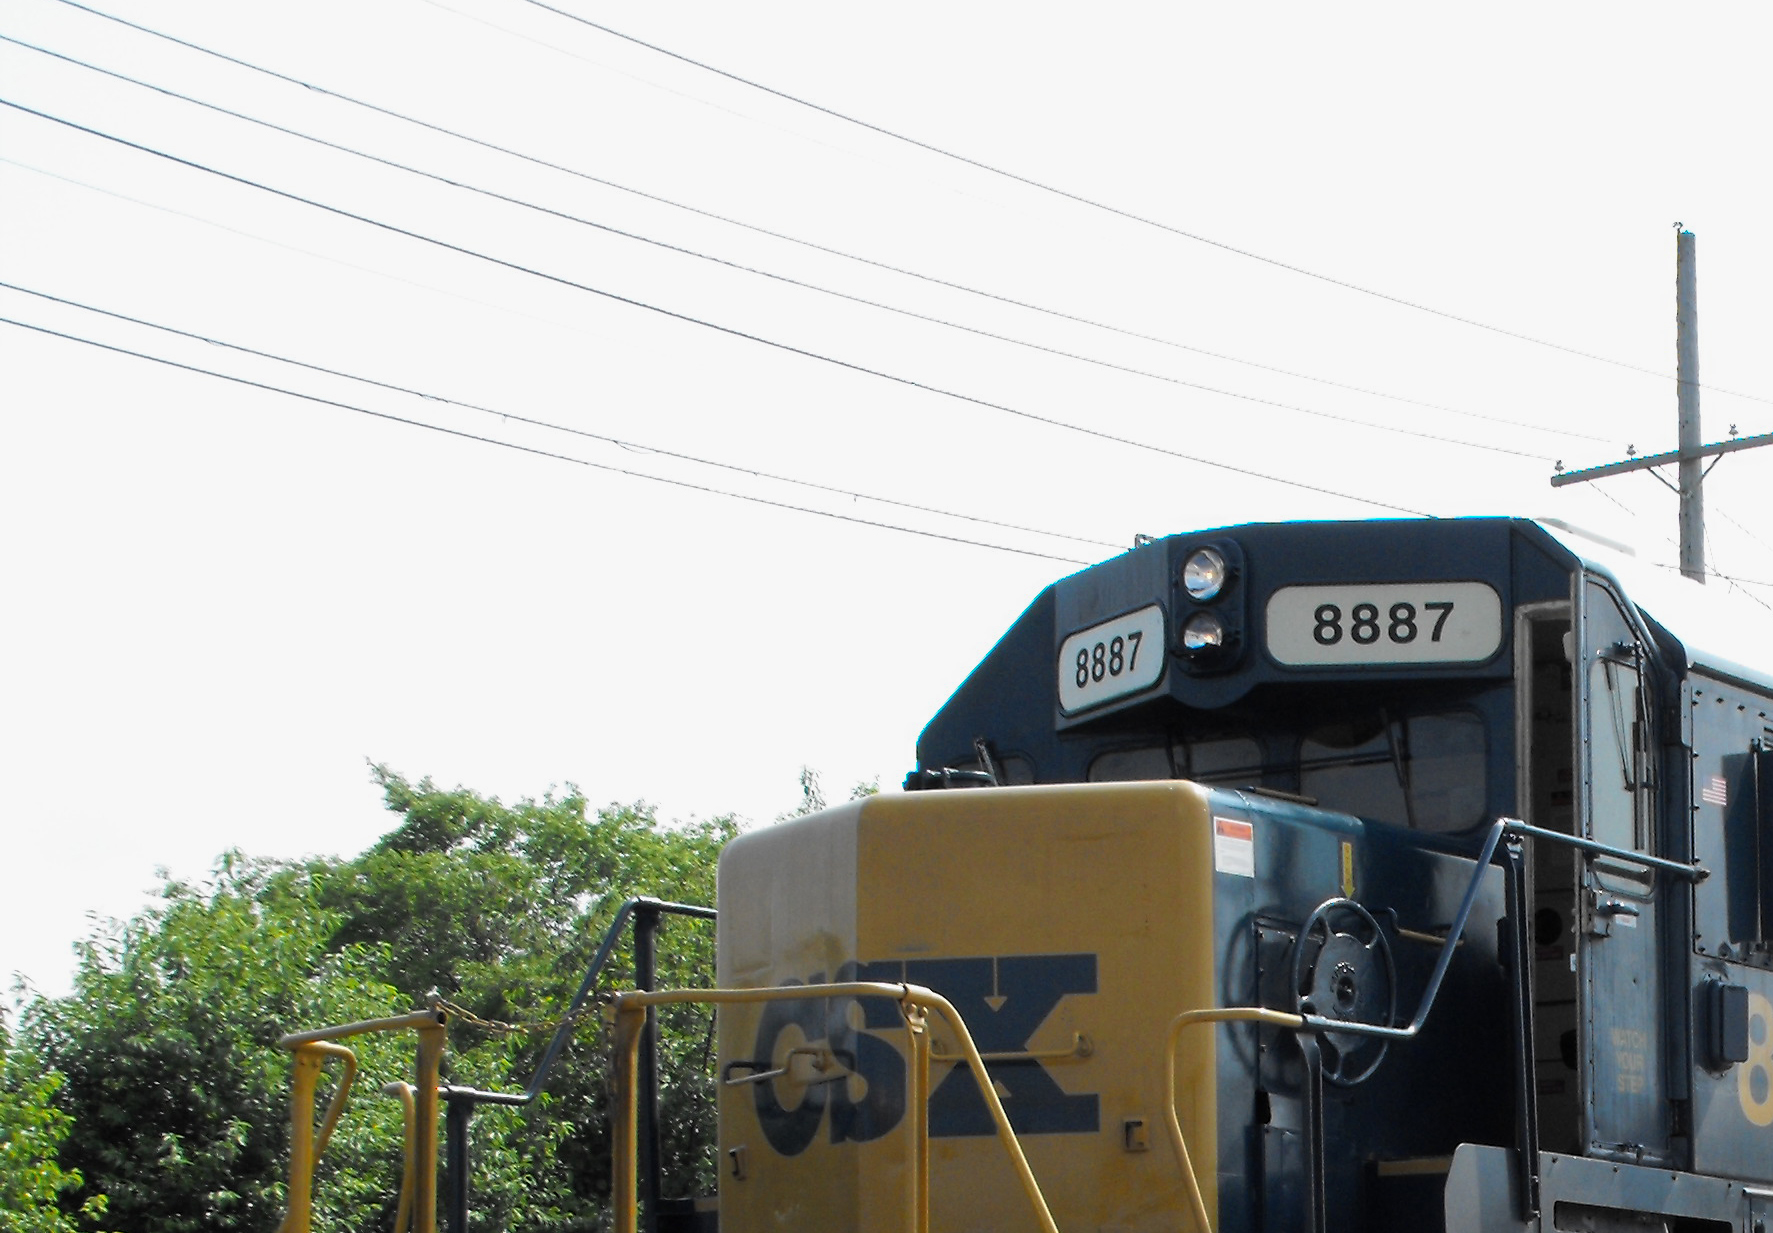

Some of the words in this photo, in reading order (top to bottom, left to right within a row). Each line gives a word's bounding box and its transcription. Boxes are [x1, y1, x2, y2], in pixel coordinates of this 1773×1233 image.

[1312, 601, 1455, 646] 8887
[1075, 630, 1143, 689] 8887
[753, 953, 1100, 1158] CSX
